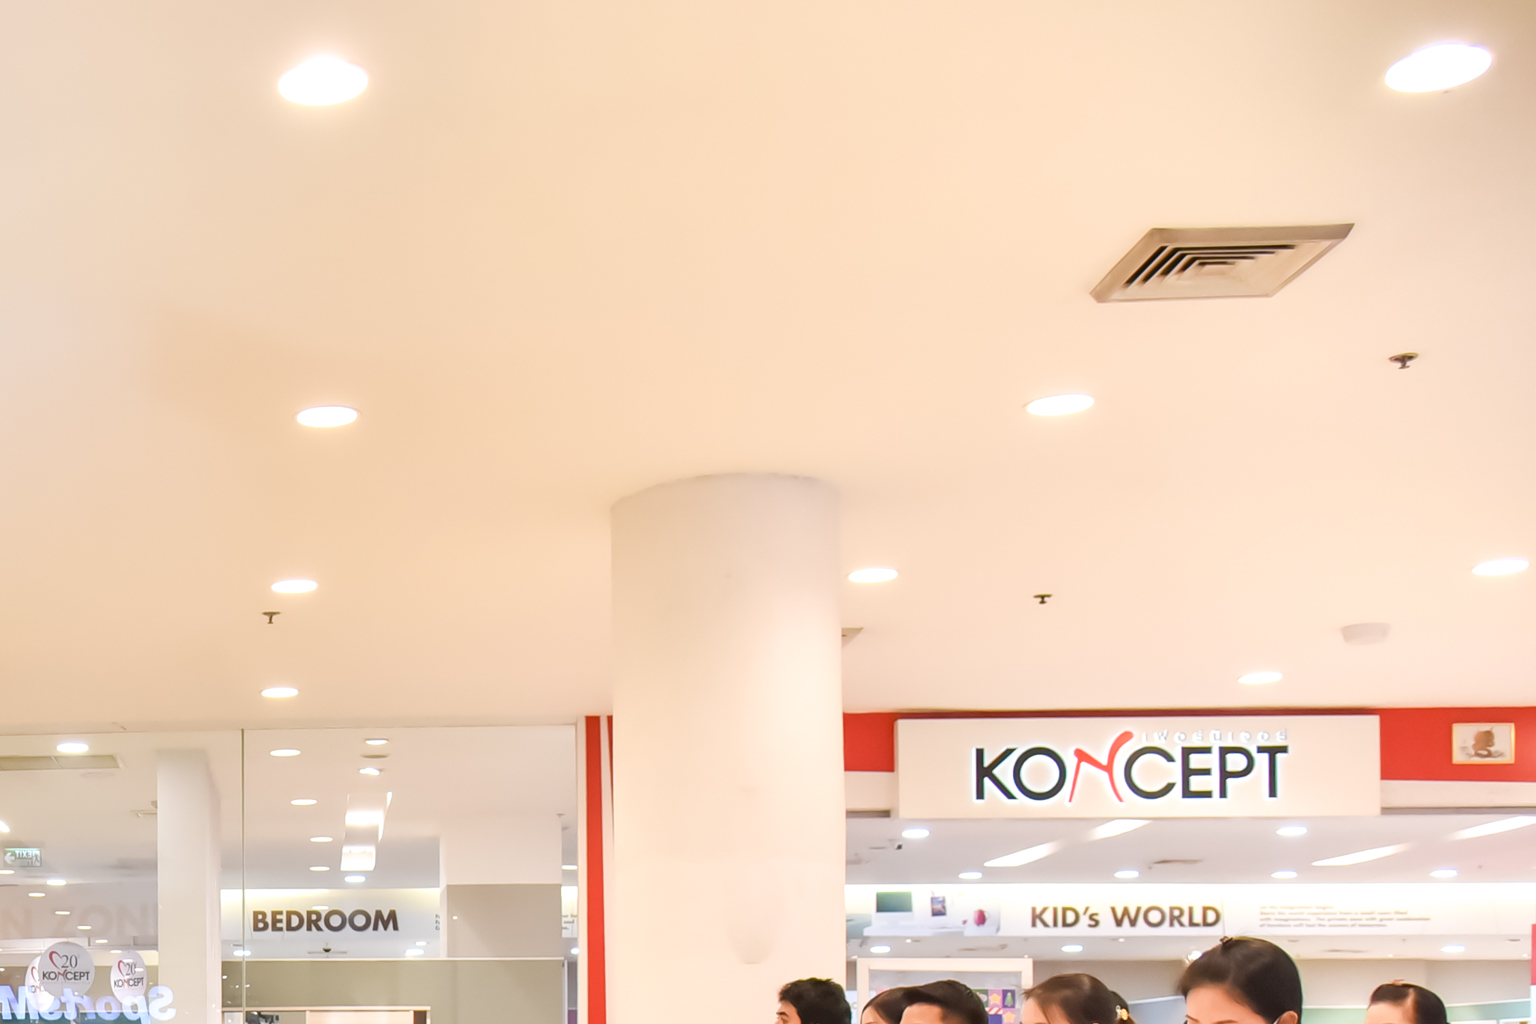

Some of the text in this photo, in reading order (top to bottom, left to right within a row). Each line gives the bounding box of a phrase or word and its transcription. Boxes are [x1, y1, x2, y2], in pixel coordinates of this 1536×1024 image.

[975, 730, 1289, 803] KONCEPT
[252, 909, 399, 932] BEDROOM
[1031, 905, 1221, 928] KID's WORLD
[42, 969, 91, 981] KONCEPT
[114, 977, 144, 989] KONCEPT
